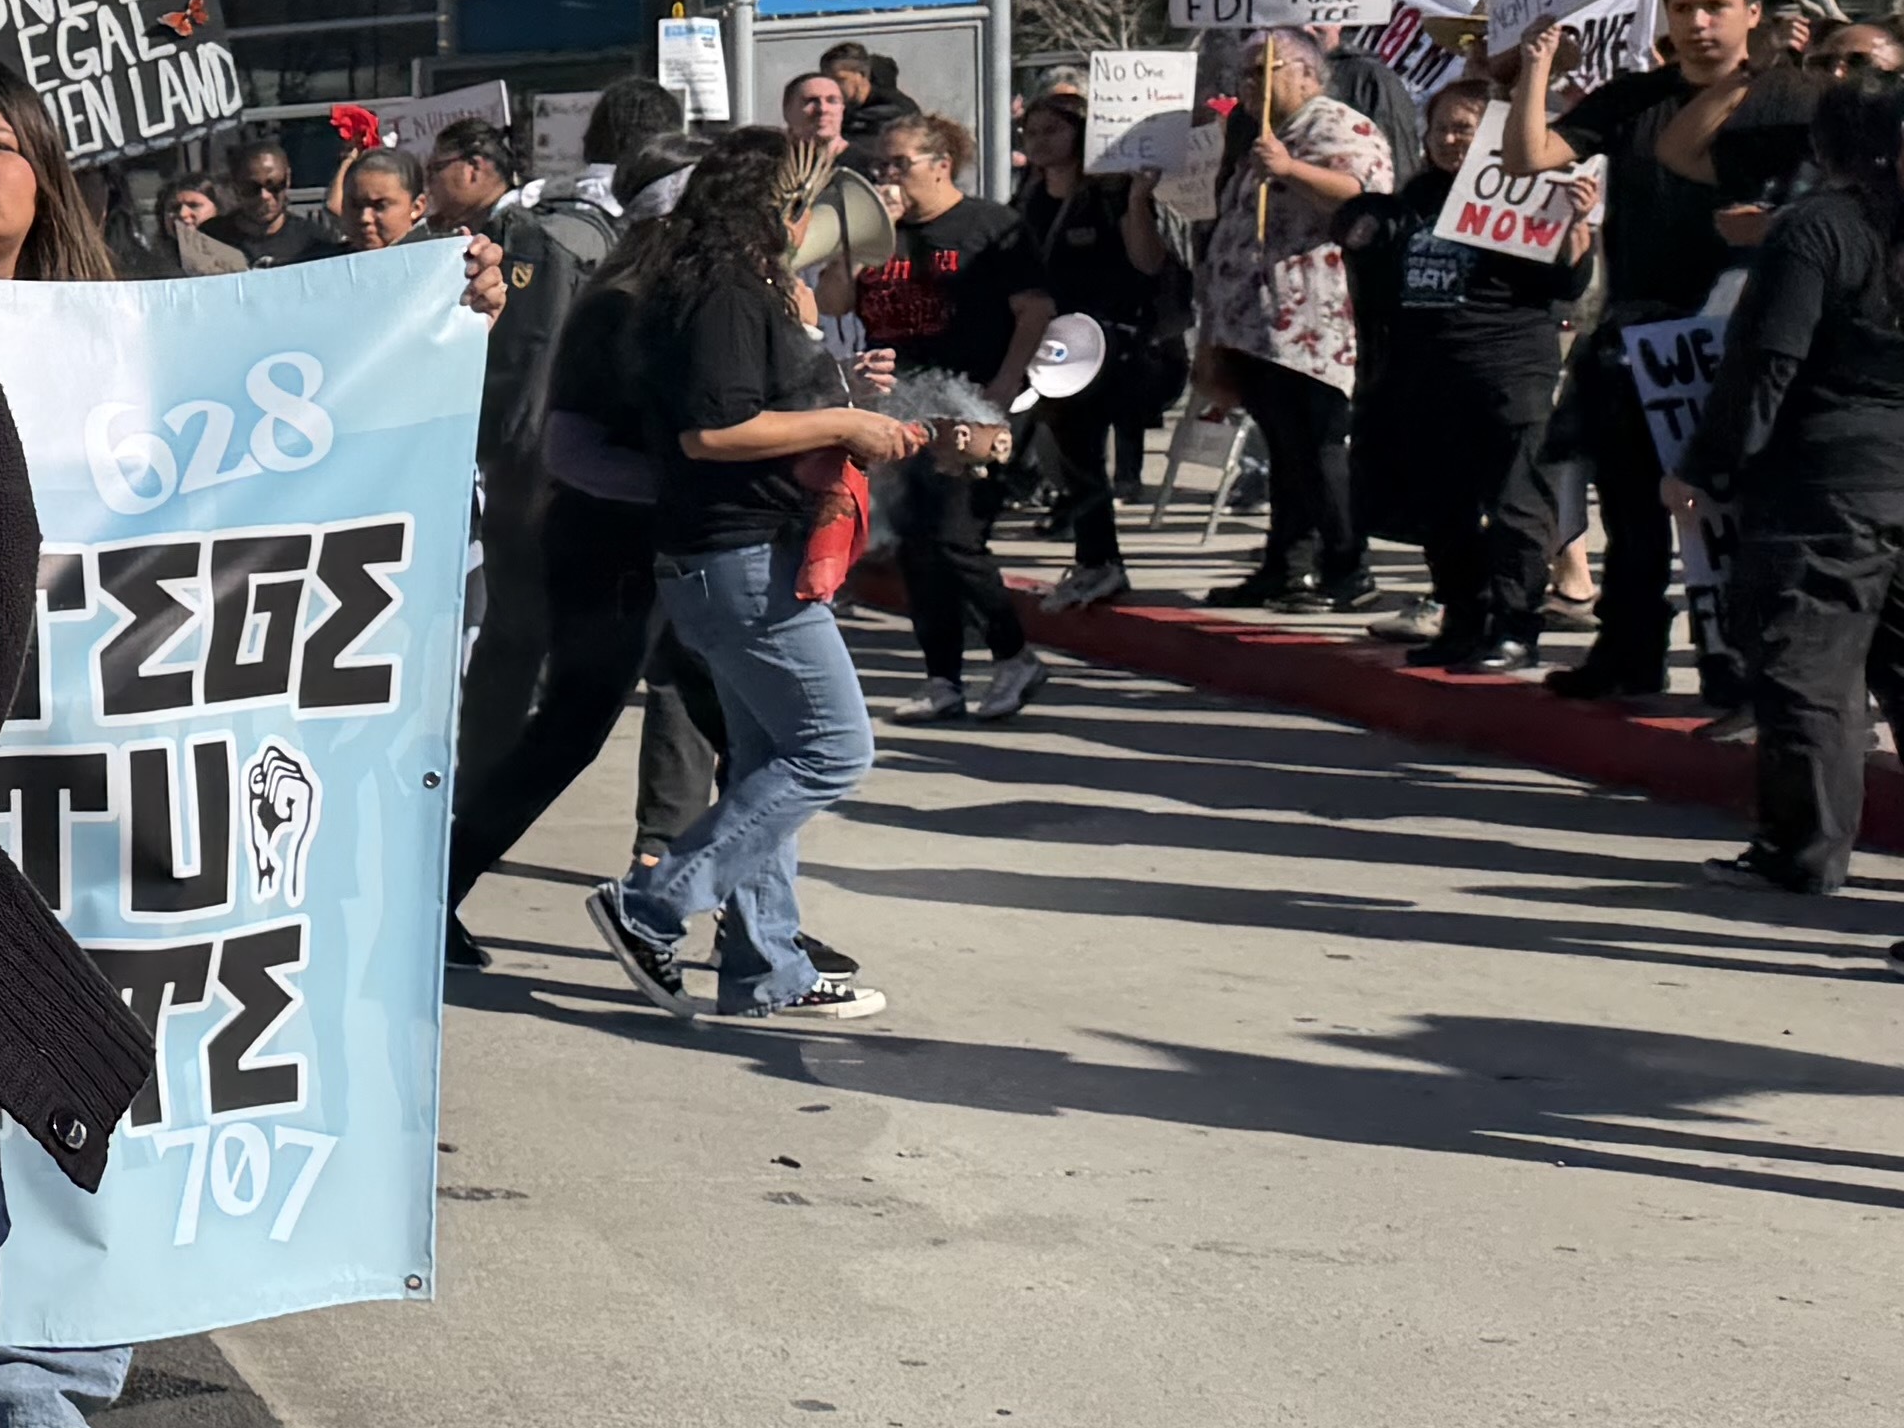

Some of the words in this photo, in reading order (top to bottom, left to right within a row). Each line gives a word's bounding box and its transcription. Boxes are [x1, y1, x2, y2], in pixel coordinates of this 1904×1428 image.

[128, 42, 243, 138] LAND
[1094, 57, 1125, 82] No
[1474, 163, 1578, 210] OUT
[1456, 201, 1563, 248] NOW
[83, 350, 334, 516] 628
[150, 1123, 339, 1246] 707
